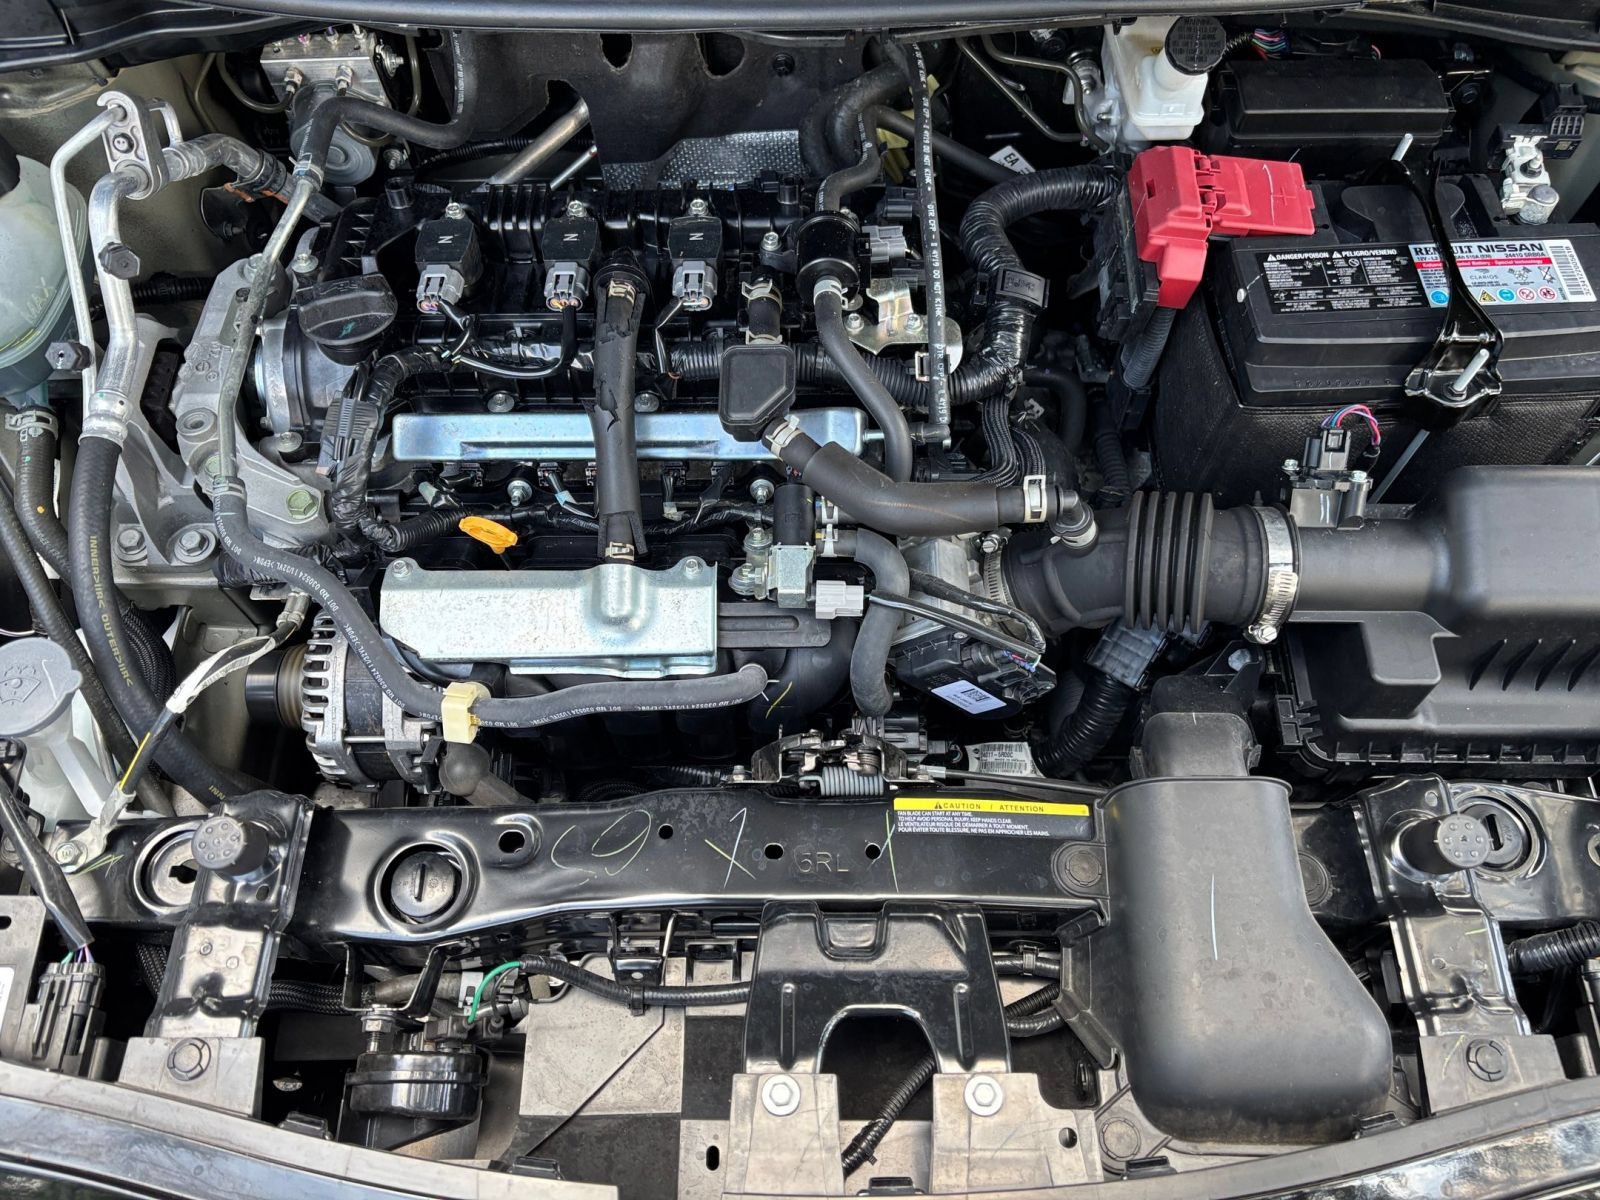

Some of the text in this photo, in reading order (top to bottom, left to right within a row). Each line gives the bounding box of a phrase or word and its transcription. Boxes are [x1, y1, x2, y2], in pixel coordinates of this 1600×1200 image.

[1003, 152, 1020, 167] EA
[1276, 249, 1398, 260] DANGER/POISON PELIGRO/VENENO
[1413, 243, 1544, 256] RENULT NISSAN
[933, 270, 940, 279] DO
[298, 571, 320, 590] 030524
[328, 600, 339, 612] DOT
